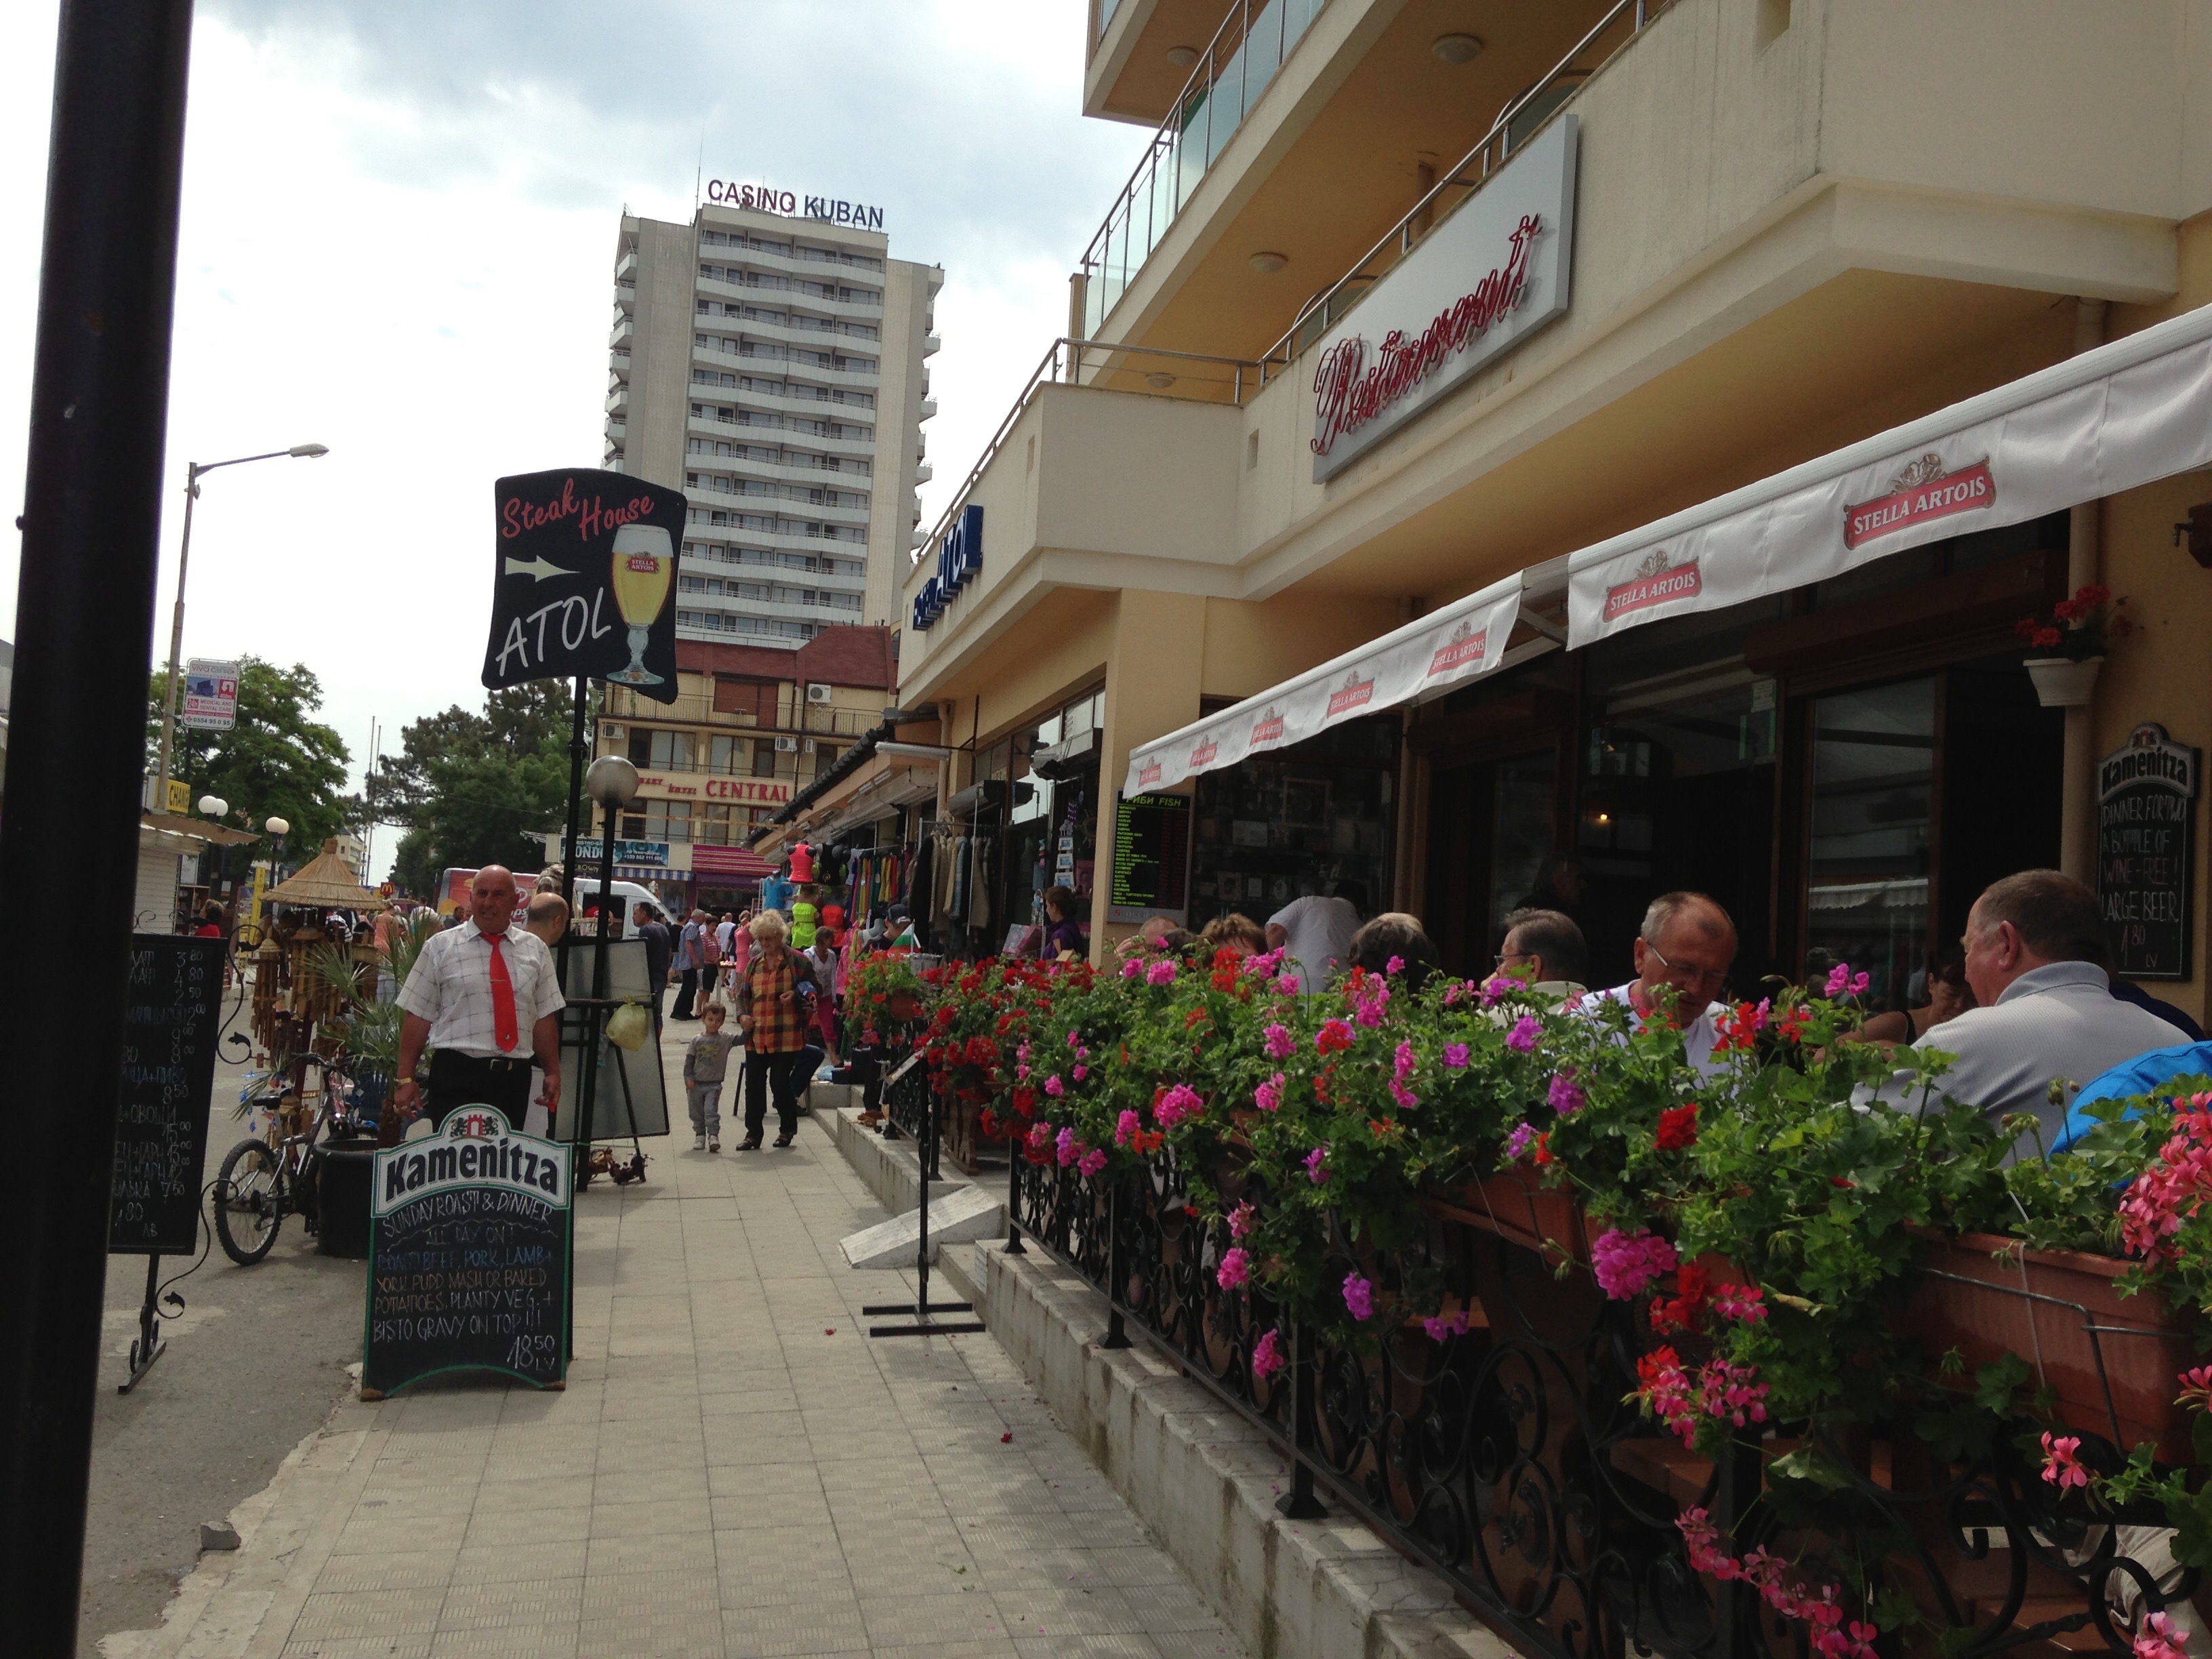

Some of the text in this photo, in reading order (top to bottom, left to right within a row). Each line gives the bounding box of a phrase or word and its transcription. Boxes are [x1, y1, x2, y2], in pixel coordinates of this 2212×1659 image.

[708, 180, 883, 228] CASINO KUBAN
[502, 478, 655, 541] Steak House
[1853, 476, 1986, 535] STELLA ARTOIS
[1610, 571, 1696, 611] STELLA ARTOIS
[495, 588, 611, 676] ATOL
[1433, 638, 1485, 669] STELLA ARTOIS
[2102, 746, 2188, 796] Kamenitza
[705, 780, 789, 802] CENTRAL
[1159, 797, 1181, 806] FISH
[2103, 796, 2143, 827] DINNER
[2102, 829, 2171, 854] A BOTTLE OF
[2103, 857, 2134, 884] WINE
[2102, 891, 2139, 922] LARGE
[386, 1138, 558, 1202] Kamenitza
[383, 1190, 553, 1237] SUNDAY ROAST & DINNER
[426, 1227, 450, 1245] ALL
[456, 1227, 480, 1244] DAY
[377, 1274, 407, 1294] YORK
[486, 1271, 501, 1288] OR
[504, 1267, 546, 1288] BAKED
[450, 1290, 501, 1310] PLANTY
[544, 1291, 554, 1307] +
[373, 1318, 413, 1343] BISTO
[417, 1316, 466, 1342] GRAVY
[470, 1315, 489, 1335] ON
[535, 1357, 555, 1372] LV
